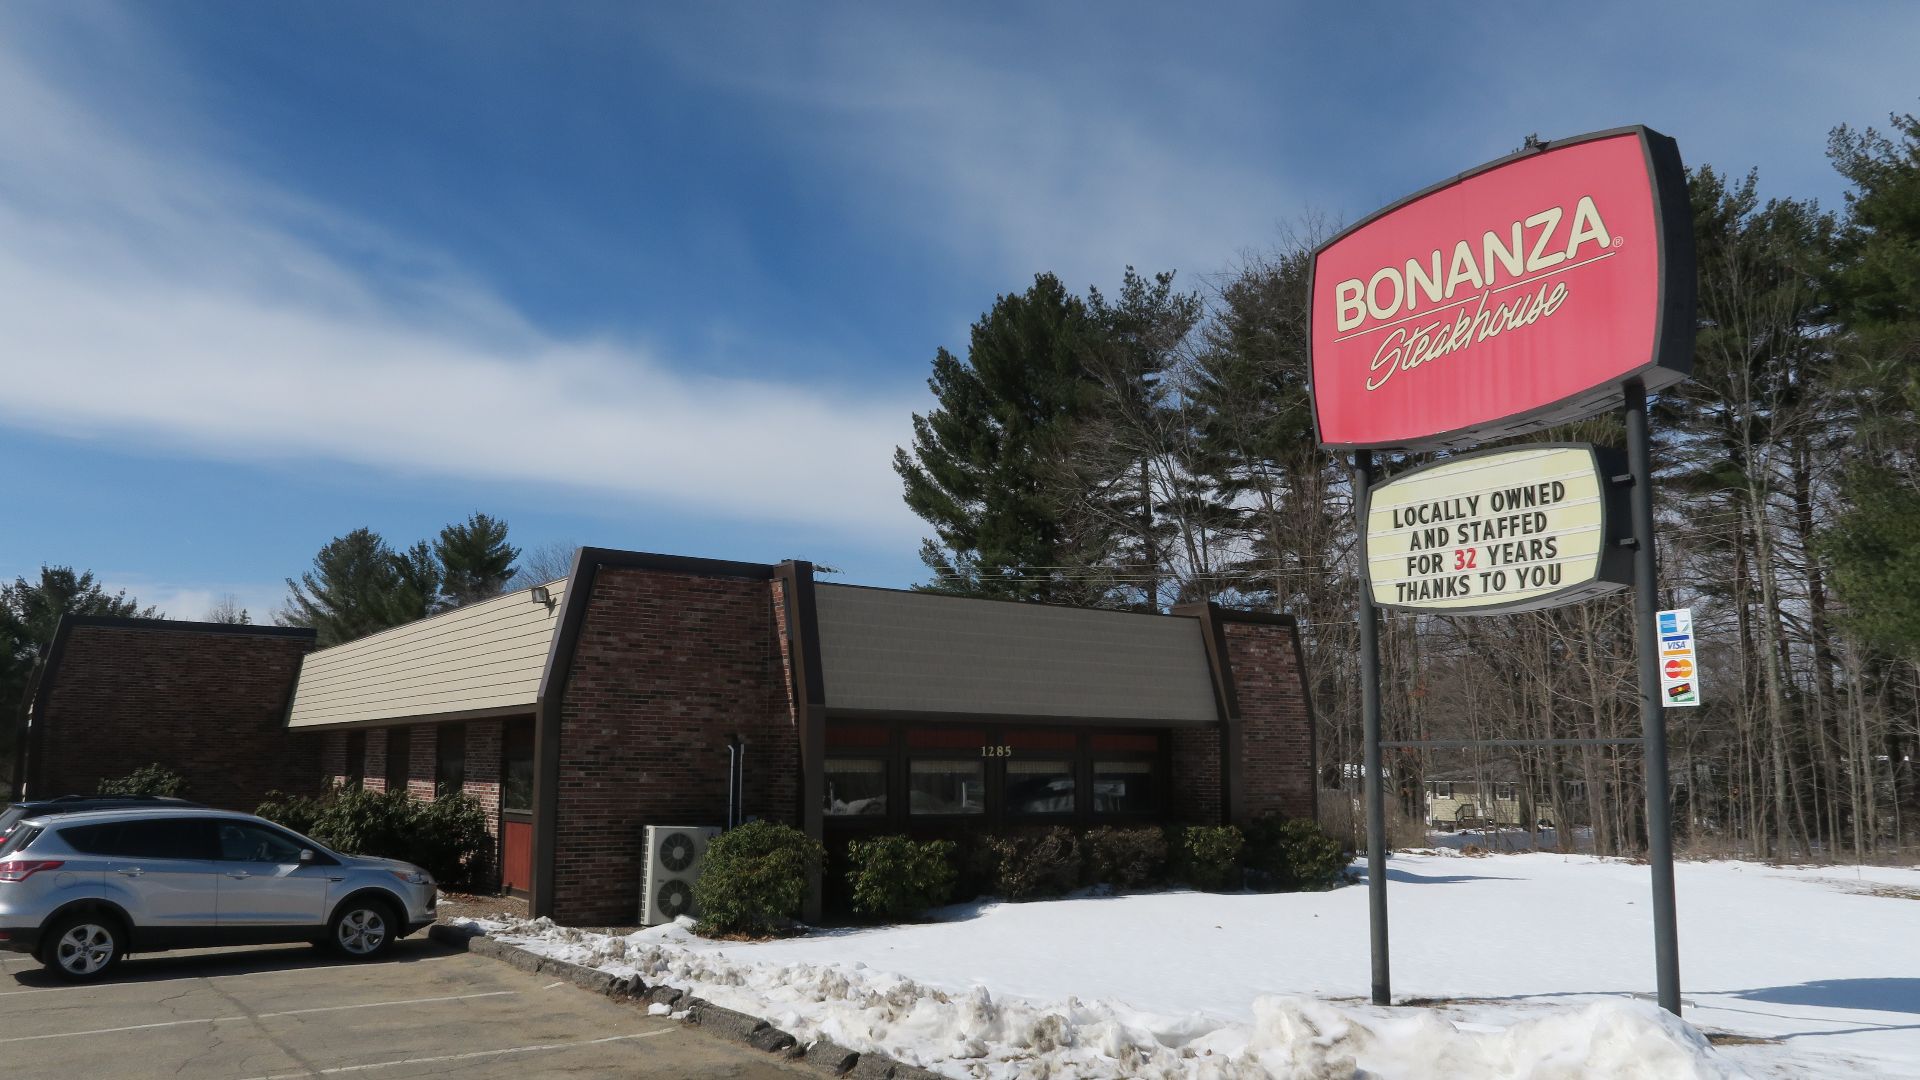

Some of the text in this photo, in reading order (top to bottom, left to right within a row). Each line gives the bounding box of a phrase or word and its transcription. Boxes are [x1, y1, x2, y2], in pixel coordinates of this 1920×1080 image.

[1335, 195, 1611, 332] BONANZA
[1366, 281, 1569, 391] Steakhouse
[1393, 480, 1565, 529] LOCALLY OWNED
[1410, 511, 1547, 551] AND STAFFED
[1407, 536, 1558, 576] FOR 32 YEARS
[1396, 563, 1561, 602] THANKS TO YOU
[1667, 641, 1686, 650] VISA
[980, 745, 1012, 757] 1285
